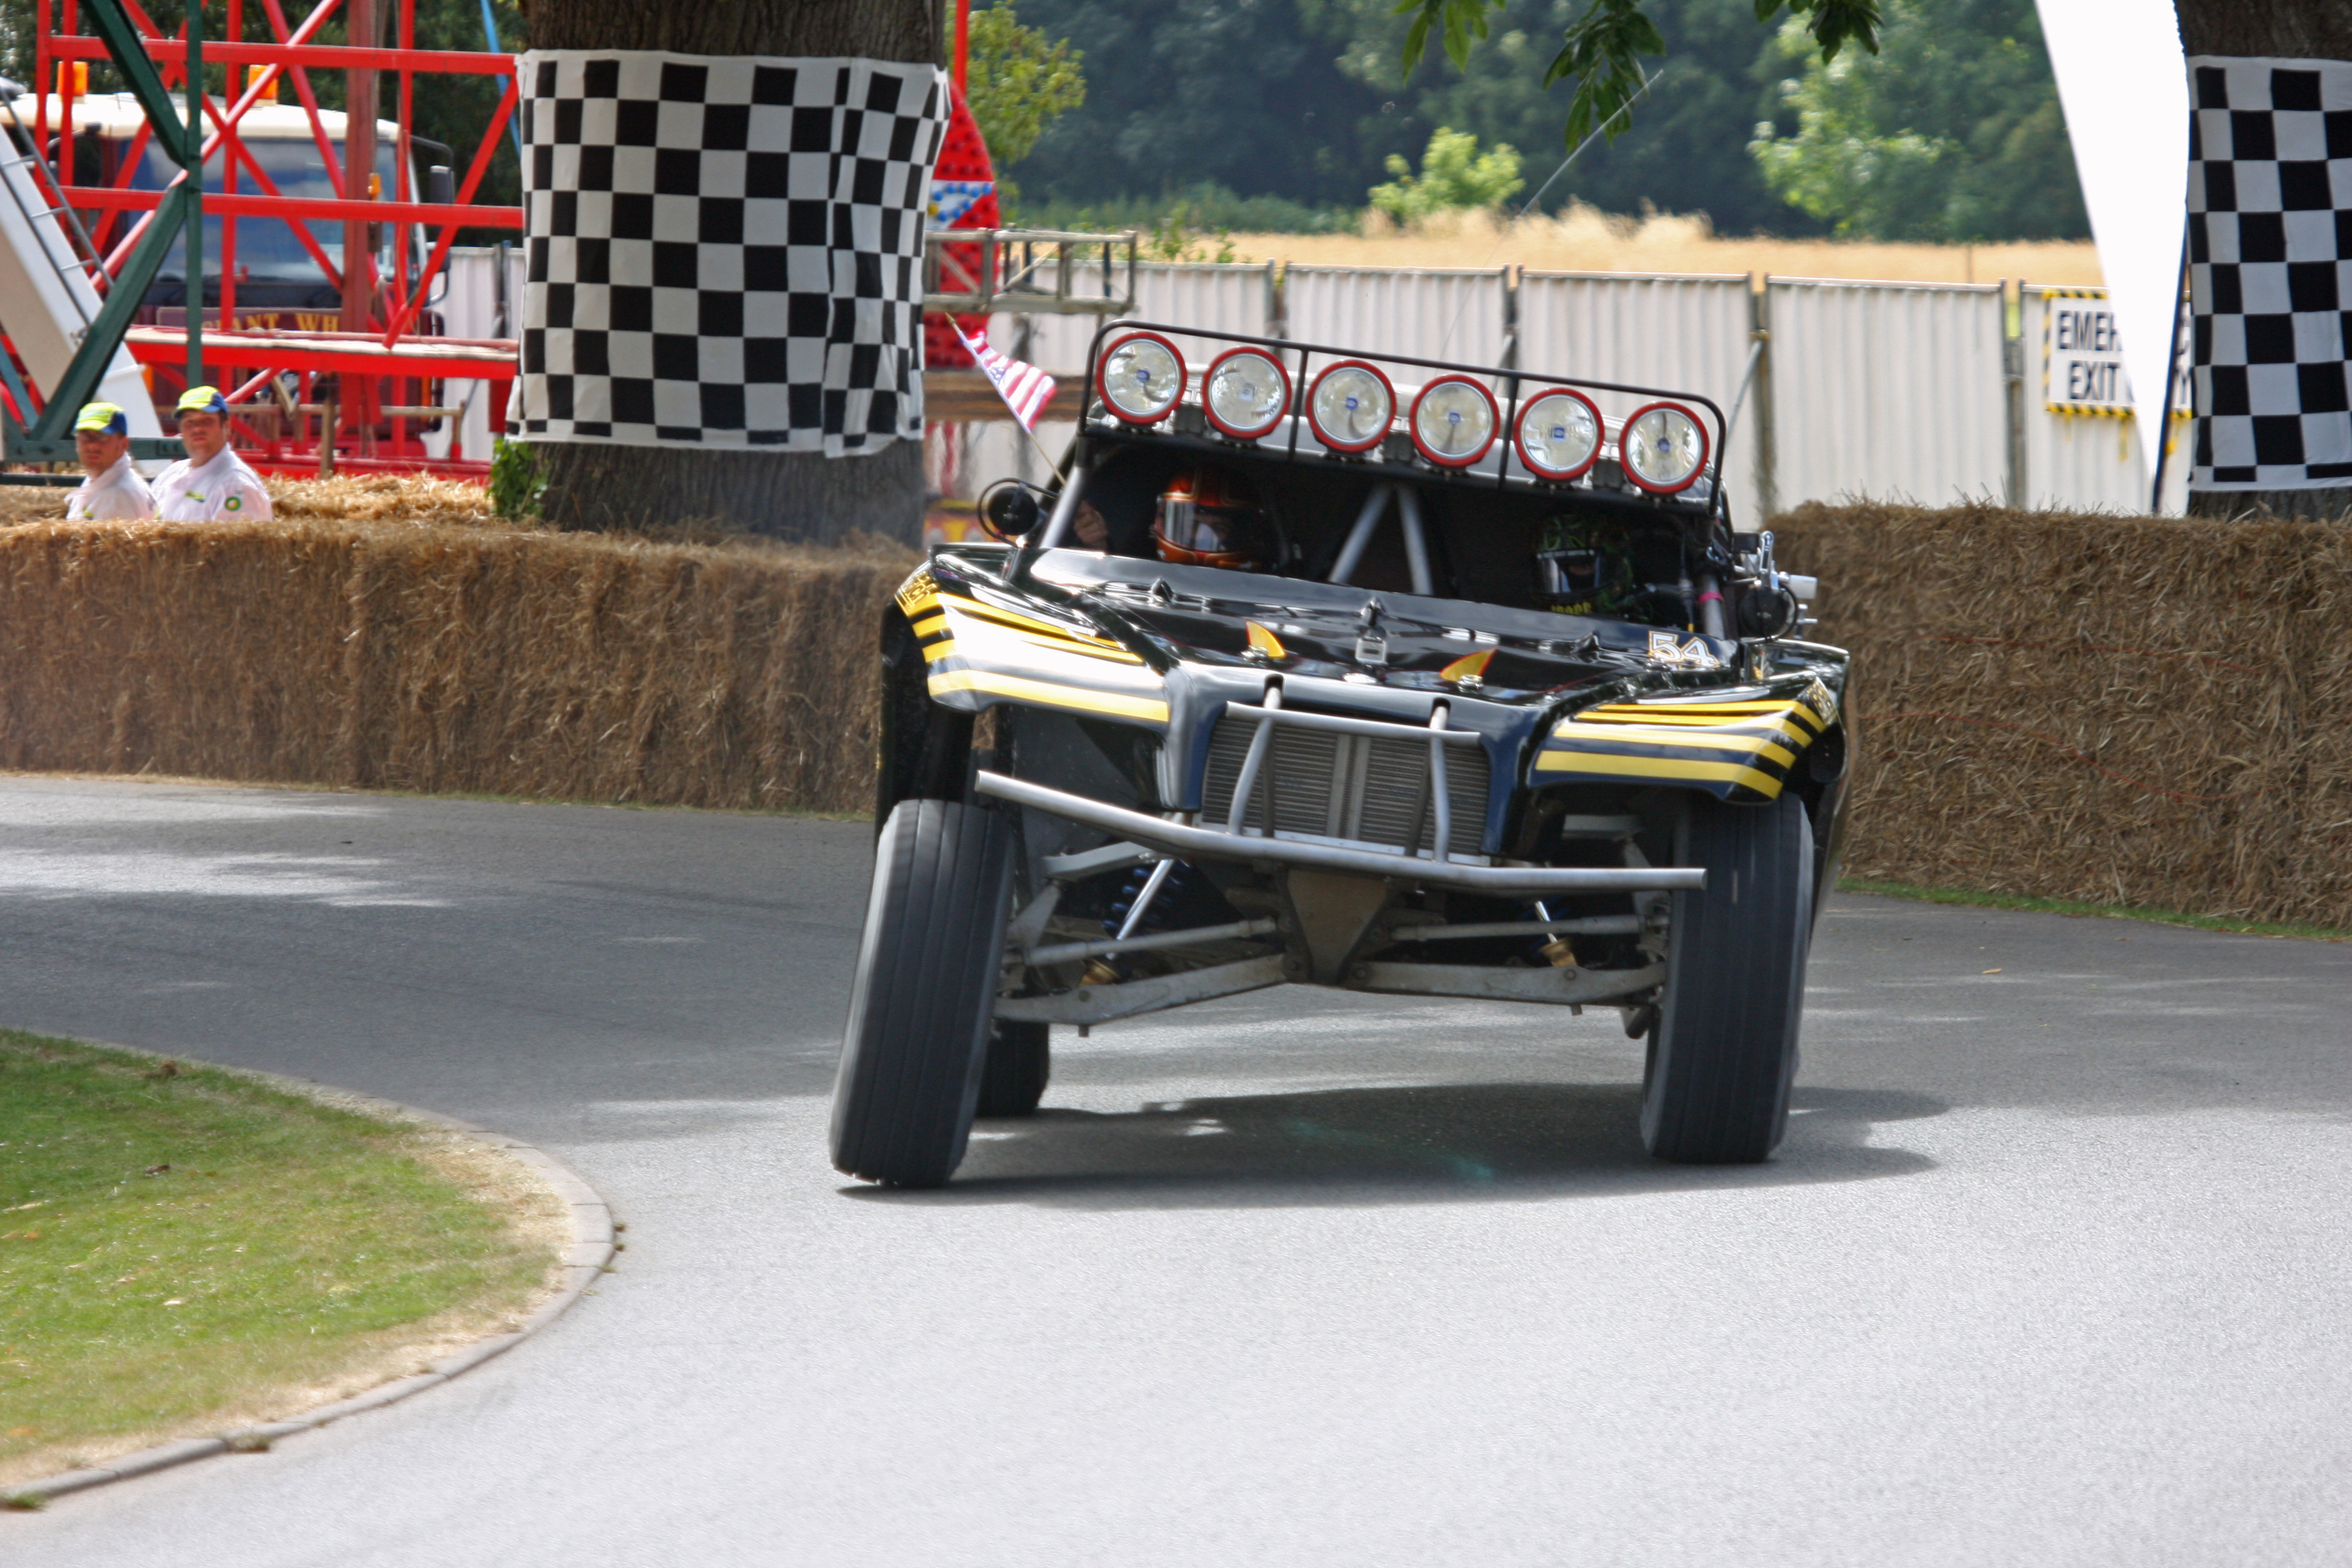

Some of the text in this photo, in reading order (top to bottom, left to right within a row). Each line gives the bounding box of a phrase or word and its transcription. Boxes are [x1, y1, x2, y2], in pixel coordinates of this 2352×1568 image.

[296, 313, 339, 332] WH
[2069, 361, 2121, 401] EXIT
[1648, 630, 1720, 668] 54
